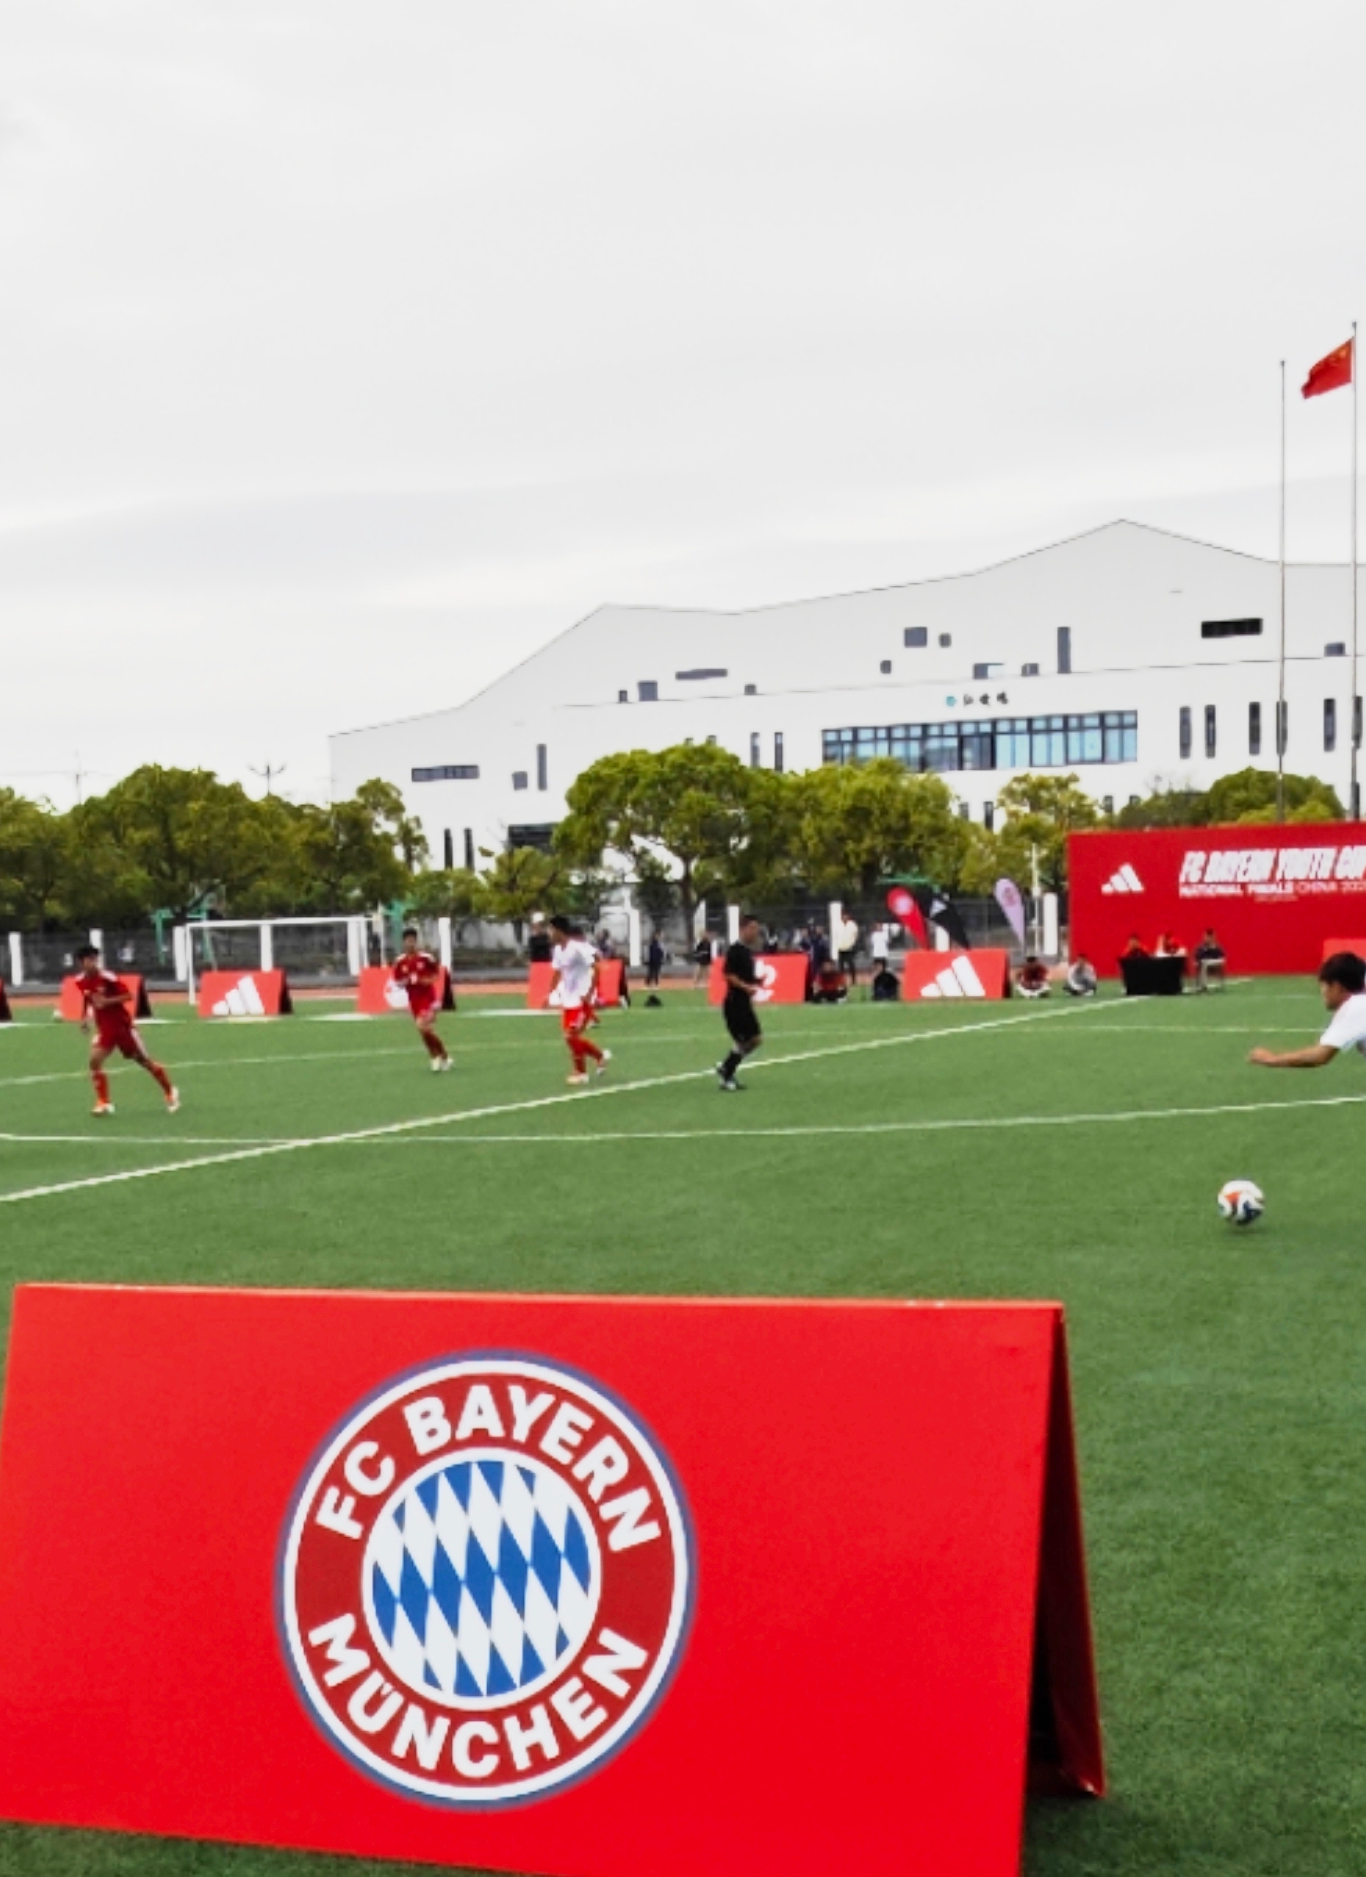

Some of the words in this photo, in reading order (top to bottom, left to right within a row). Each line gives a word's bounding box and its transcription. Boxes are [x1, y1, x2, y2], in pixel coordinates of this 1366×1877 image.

[1179, 850, 1206, 882] FC
[1204, 848, 1277, 882] BAYERN
[1276, 847, 1338, 880] YOUTH
[316, 1441, 395, 1539] FC
[403, 1385, 661, 1551] BAYERN
[309, 1613, 648, 1778] MÜNCHEN
